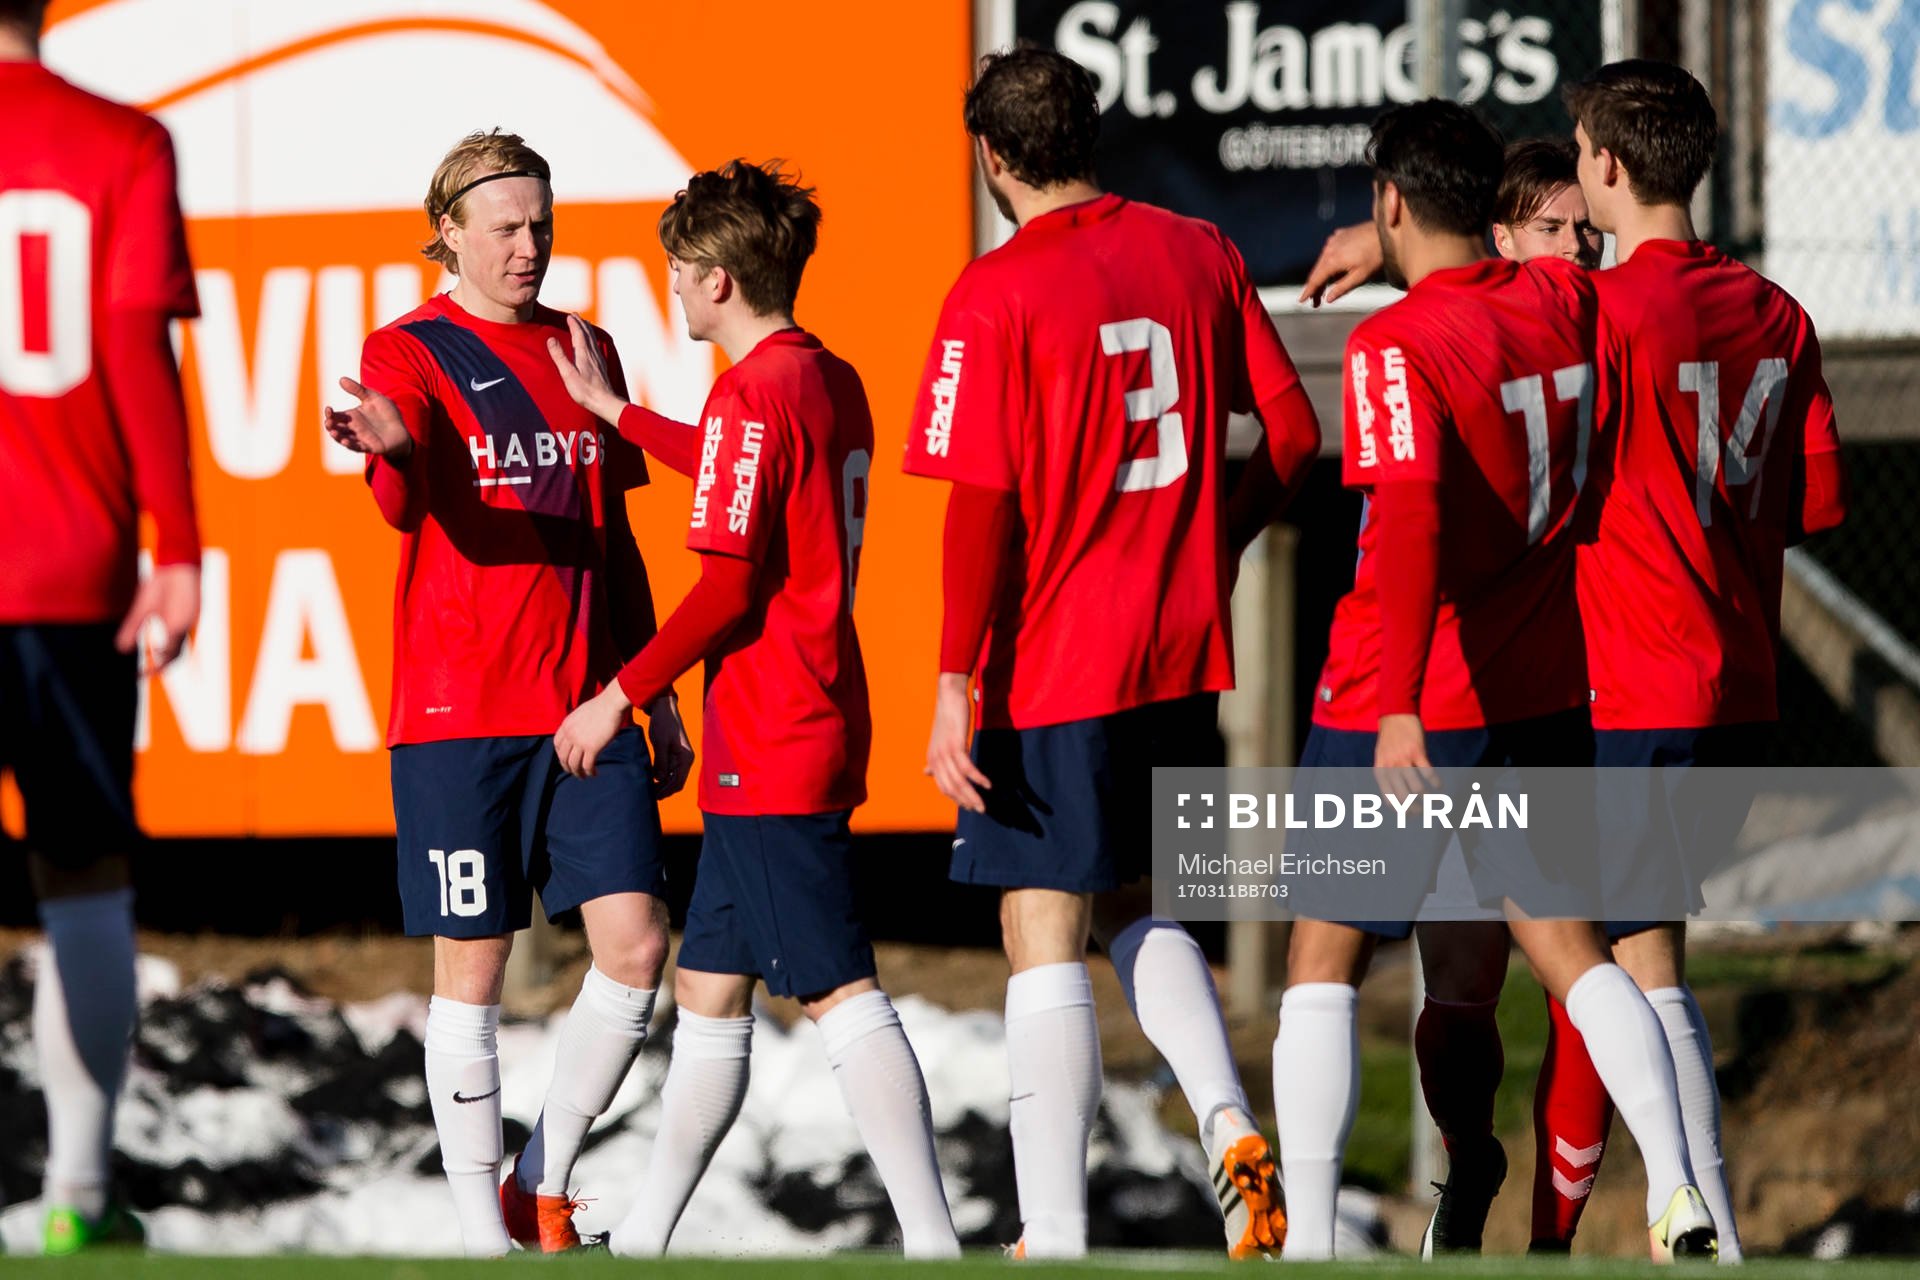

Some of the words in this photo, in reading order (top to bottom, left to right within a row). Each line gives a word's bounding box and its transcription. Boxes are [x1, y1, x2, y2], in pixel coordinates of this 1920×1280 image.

[1054, 0, 1177, 118] St.
[468, 432, 529, 470] H.A
[924, 339, 966, 458] stadium
[1099, 317, 1189, 493] 3
[1380, 346, 1416, 461] stadium
[1499, 362, 1594, 546] 17
[1678, 357, 1789, 529] 14
[690, 416, 722, 528] stadium
[727, 420, 765, 536] stadium
[428, 848, 488, 918] 18
